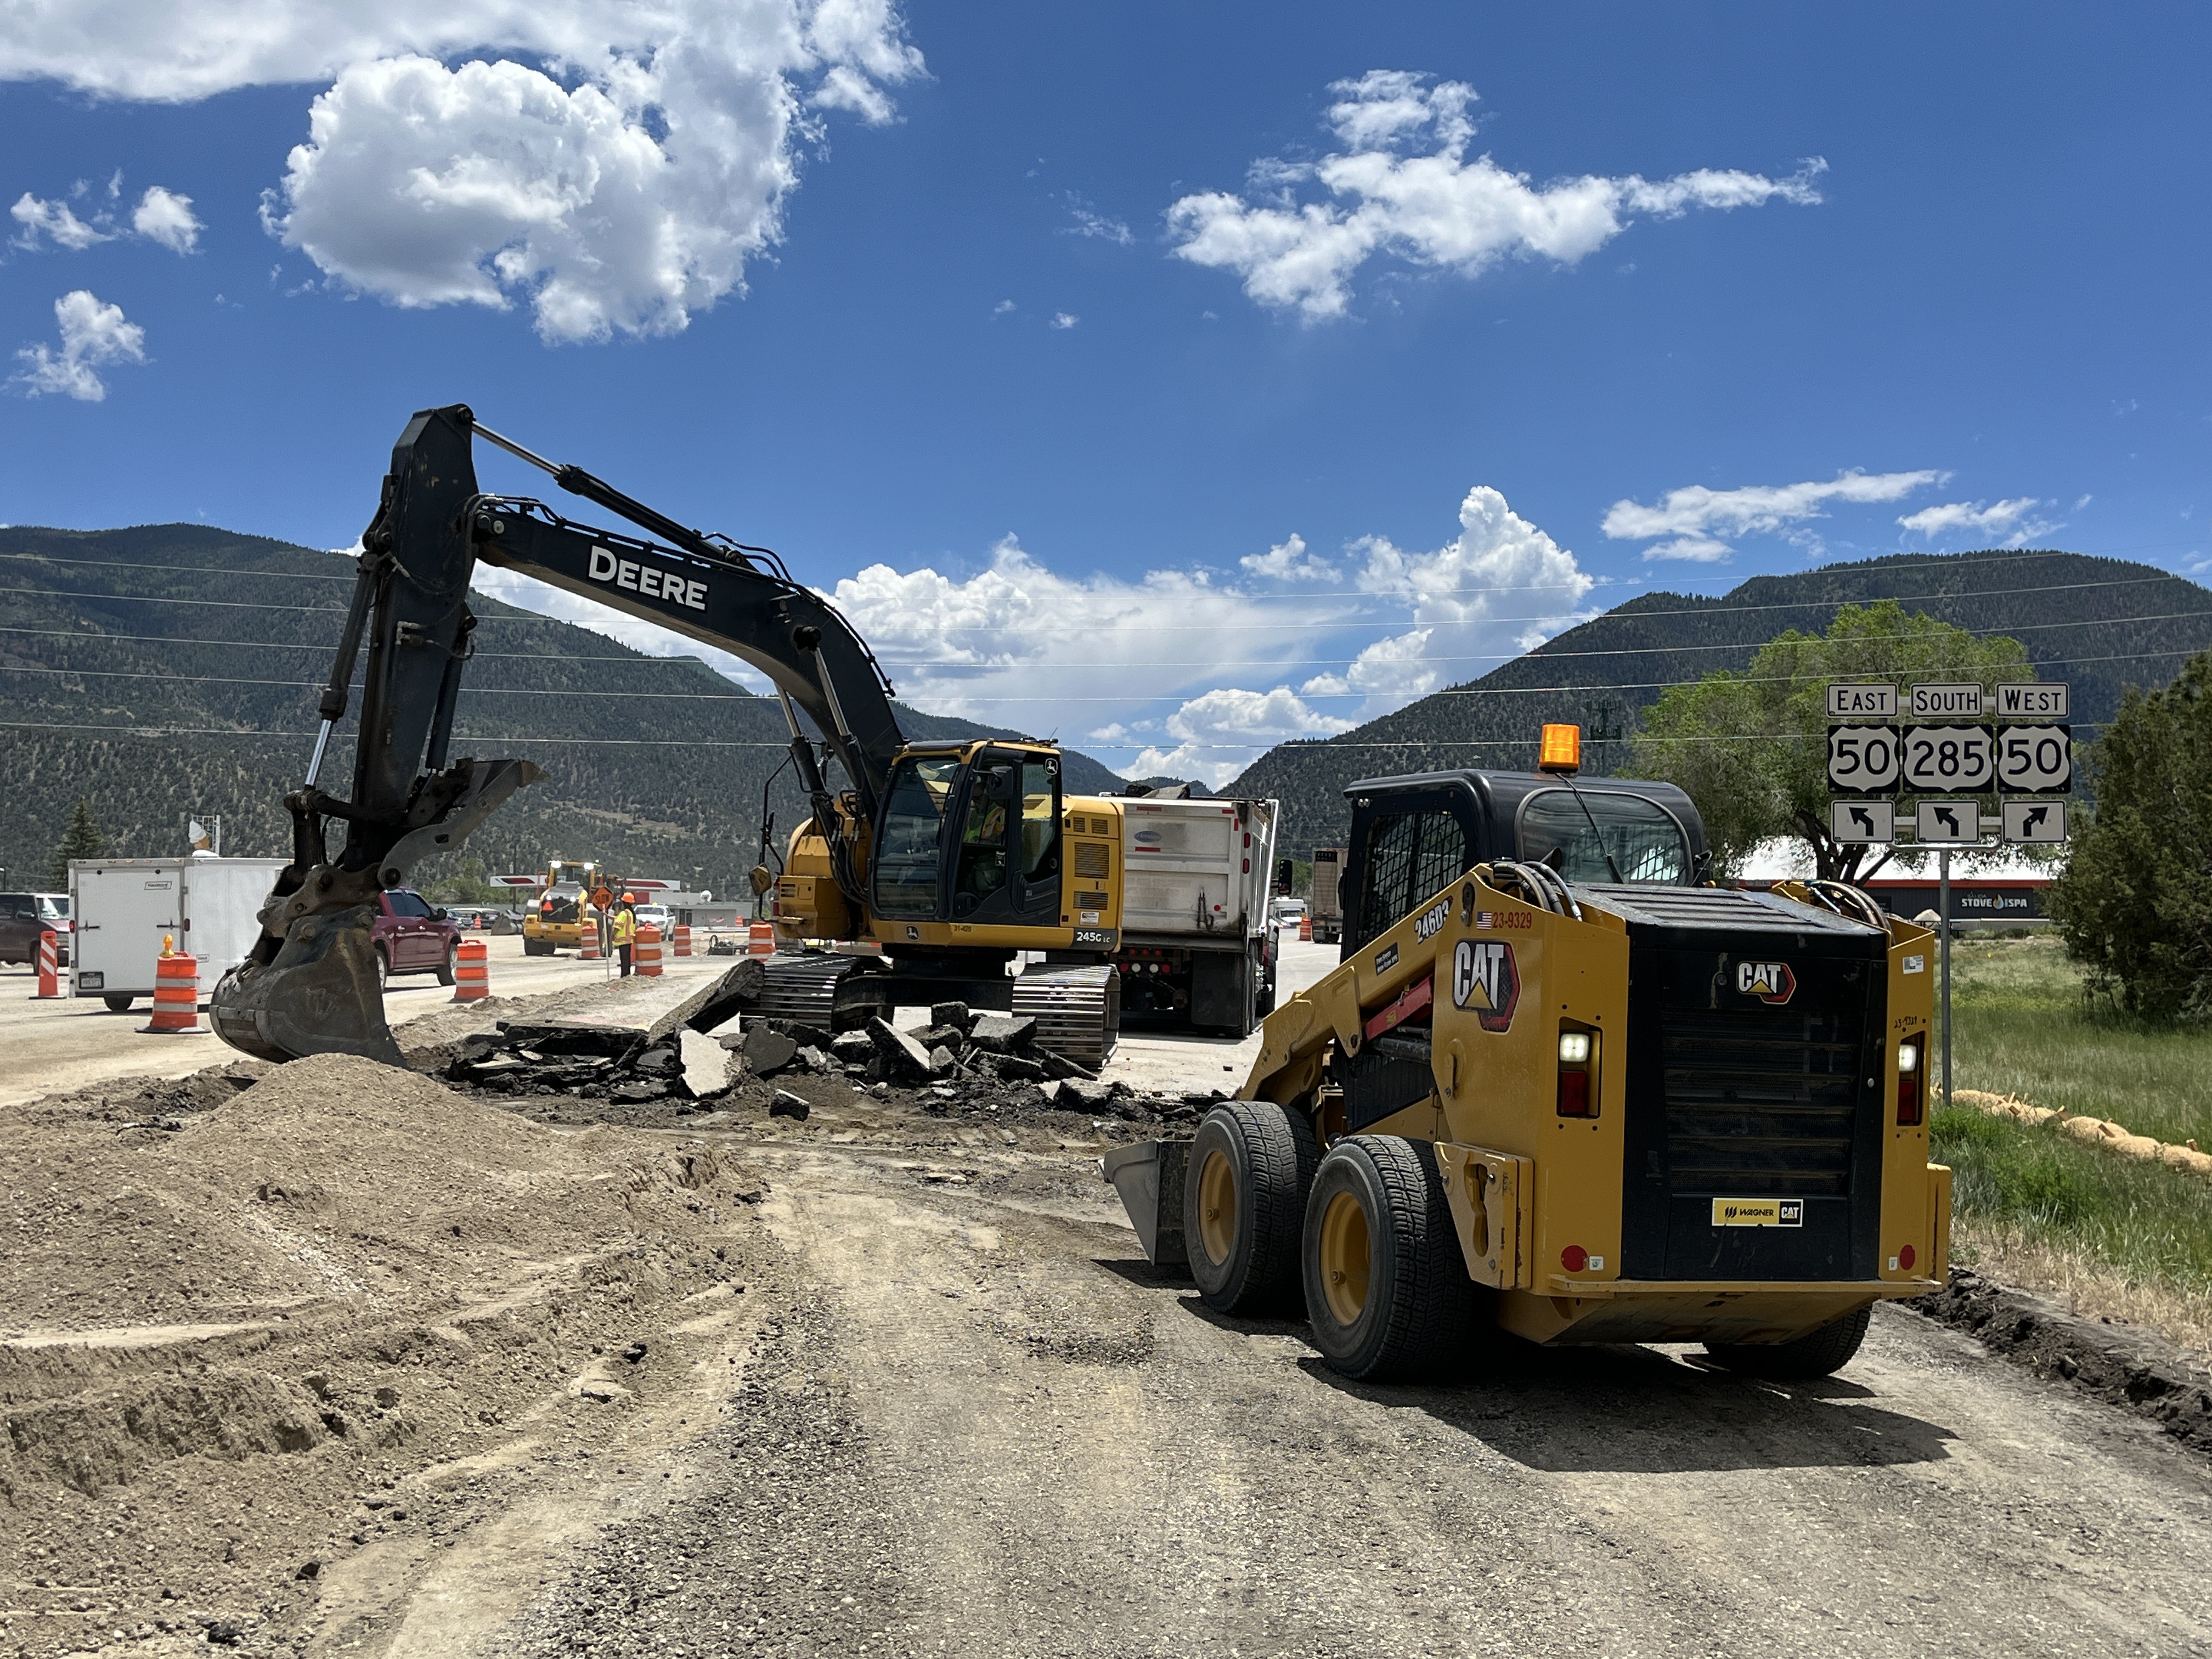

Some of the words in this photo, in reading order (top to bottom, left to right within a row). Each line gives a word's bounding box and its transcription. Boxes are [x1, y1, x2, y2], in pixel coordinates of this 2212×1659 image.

[589, 545, 707, 610] DEERE
[1837, 690, 1887, 710] EAST
[1916, 690, 1978, 711] SOUTH
[2005, 690, 2061, 710] WEST
[1836, 739, 1889, 775] 50
[1913, 741, 1984, 776] 285
[2007, 738, 2062, 774] 50
[1961, 898, 1993, 907] STOVE
[1415, 900, 1449, 943] 246D3
[1493, 911, 1532, 929] 23-9329
[1076, 931, 1102, 942] 245G
[1454, 942, 1504, 1009] CAT
[1739, 963, 1781, 994] CAT
[1740, 1209, 1774, 1217] WAGNER
[1781, 1207, 1799, 1219] CAT
